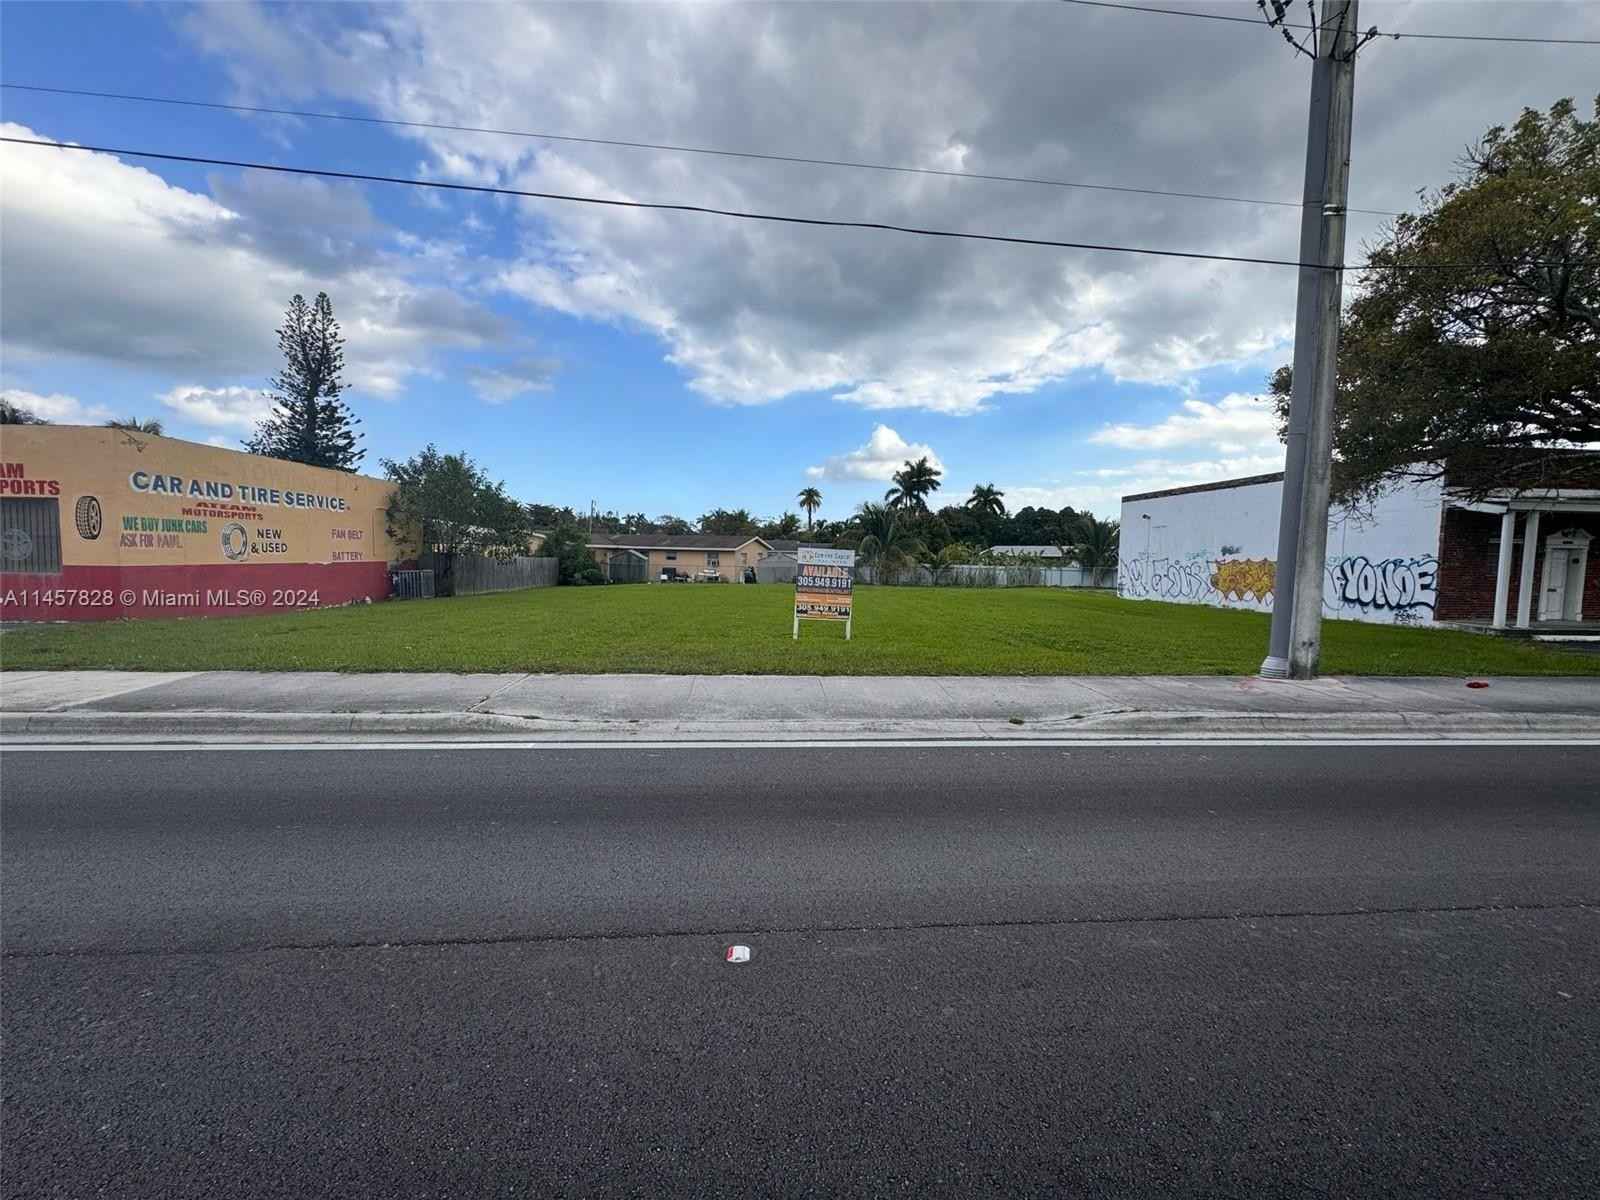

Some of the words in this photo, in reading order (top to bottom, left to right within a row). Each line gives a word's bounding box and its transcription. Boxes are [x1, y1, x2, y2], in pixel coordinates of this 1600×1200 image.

[129, 471, 183, 496] CAR
[187, 480, 233, 501] AND
[237, 486, 280, 507] TIRE
[181, 507, 263, 520] MOTORSPORTS
[122, 516, 139, 531] WE
[140, 517, 160, 532] BUY
[161, 518, 185, 533] JUNK
[185, 520, 208, 534] CARS
[257, 528, 282, 539] NEW
[331, 529, 346, 539] FAN
[347, 530, 363, 540] BELT
[120, 532, 138, 548] ASK
[139, 533, 154, 548] FOR
[250, 542, 260, 553] &
[261, 543, 288, 553] USED
[332, 552, 363, 561] BATTERY
